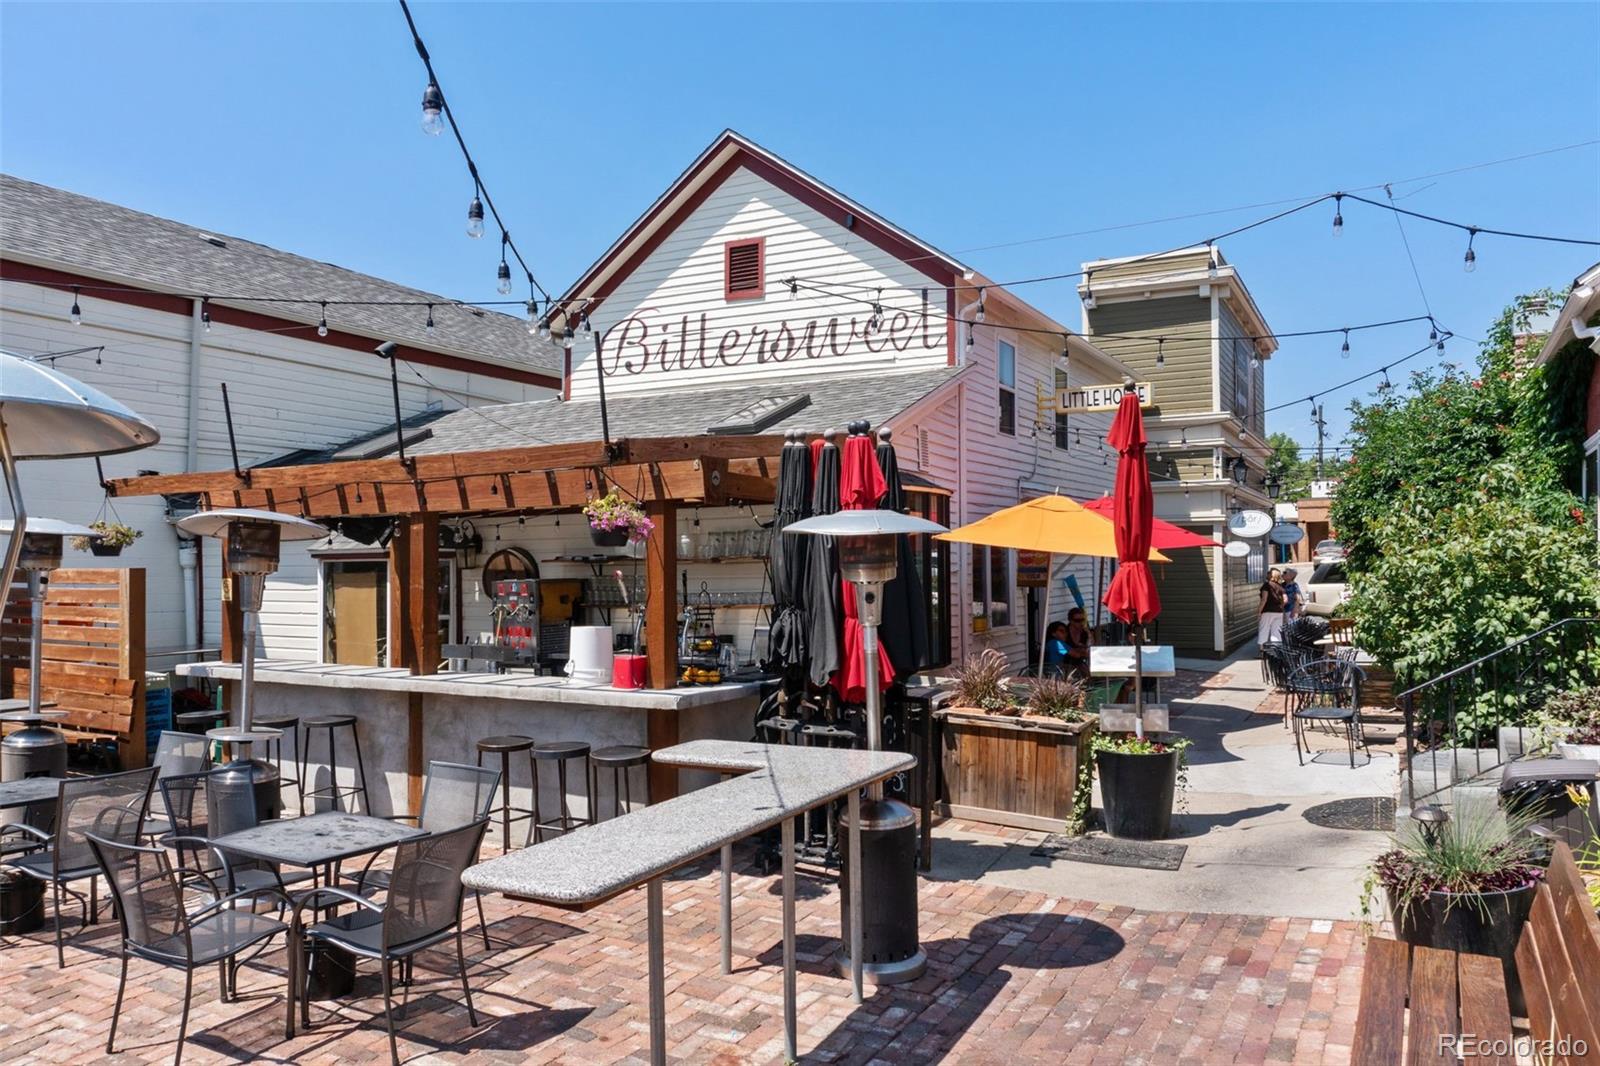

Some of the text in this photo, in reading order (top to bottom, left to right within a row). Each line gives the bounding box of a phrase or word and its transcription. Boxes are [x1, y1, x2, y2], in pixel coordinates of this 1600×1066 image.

[601, 288, 943, 376] Bittersweet
[1062, 386, 1145, 408] LITTLE HOE
